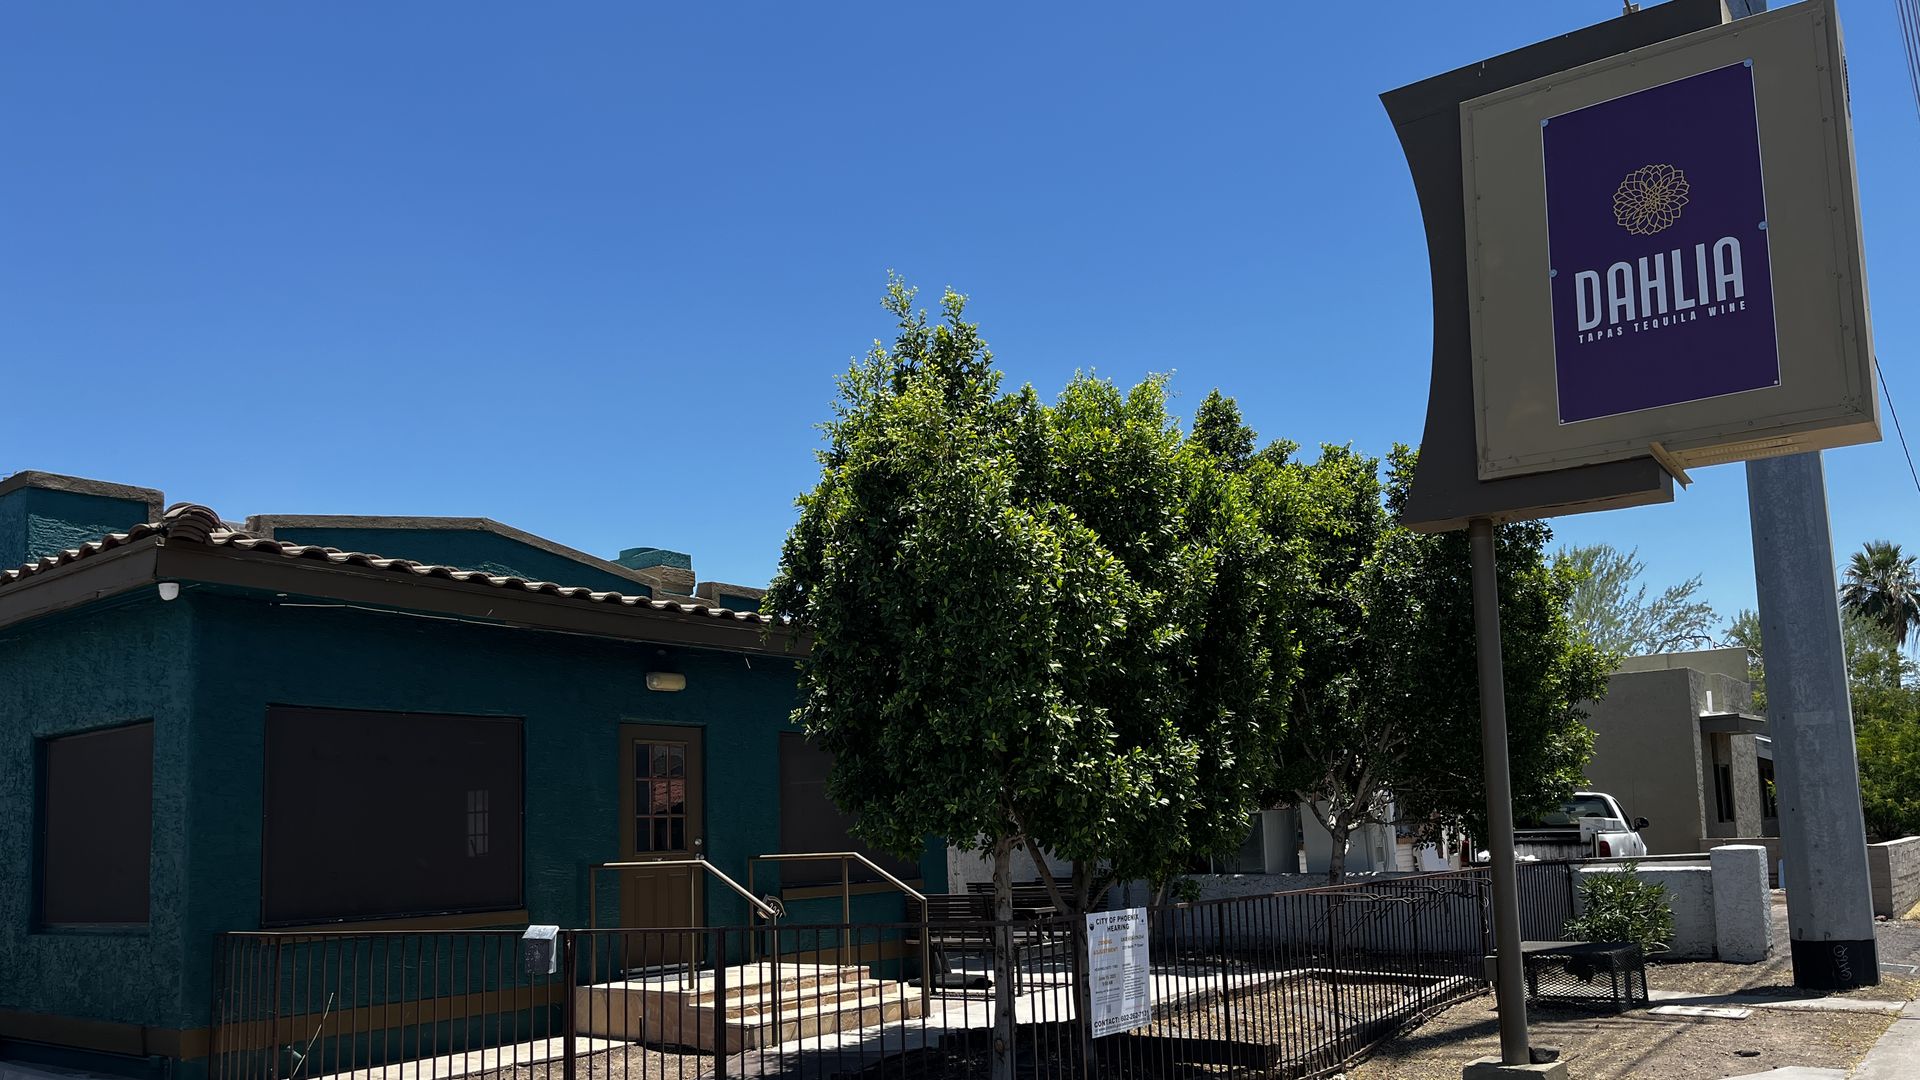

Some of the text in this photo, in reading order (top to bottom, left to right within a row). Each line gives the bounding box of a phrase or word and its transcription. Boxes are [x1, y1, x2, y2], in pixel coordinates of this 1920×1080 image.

[1575, 236, 1744, 331] DAHLIA
[1579, 301, 1746, 344] TAPAS TEQUILA WINE
[1096, 914, 1139, 925] CITY OF PHOENIX
[1107, 923, 1130, 931] HEARING
